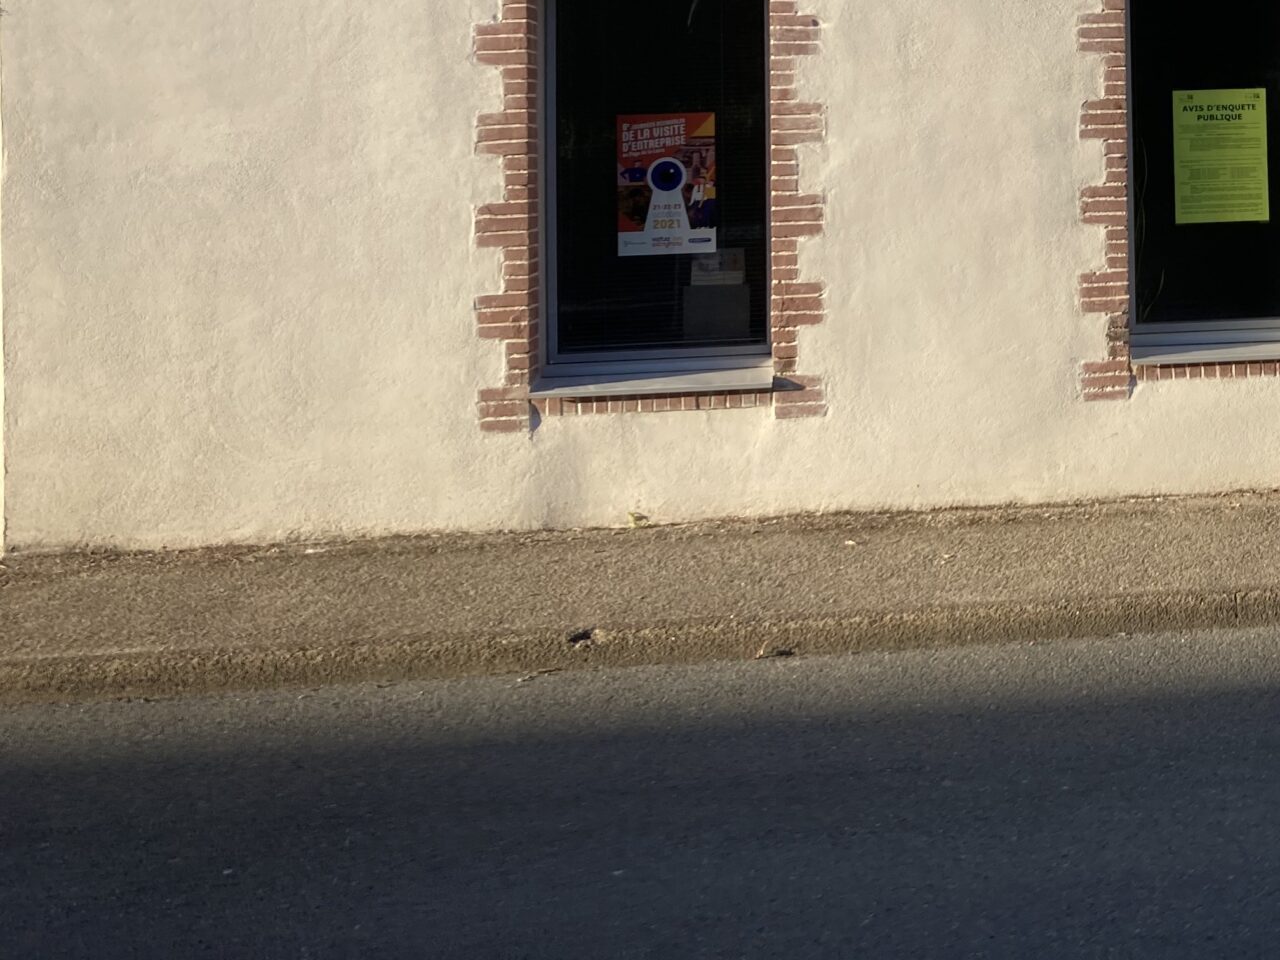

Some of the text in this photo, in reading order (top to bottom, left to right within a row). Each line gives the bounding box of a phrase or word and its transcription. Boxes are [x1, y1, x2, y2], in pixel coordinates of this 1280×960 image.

[1182, 104, 1204, 113] AVIS
[1197, 113, 1243, 121] PUBLIQUE
[622, 130, 635, 142] DE
[637, 128, 650, 139] LA
[652, 123, 686, 137] VISITE
[622, 135, 687, 152] D'ENTREPRISE
[653, 219, 680, 229] 2021
